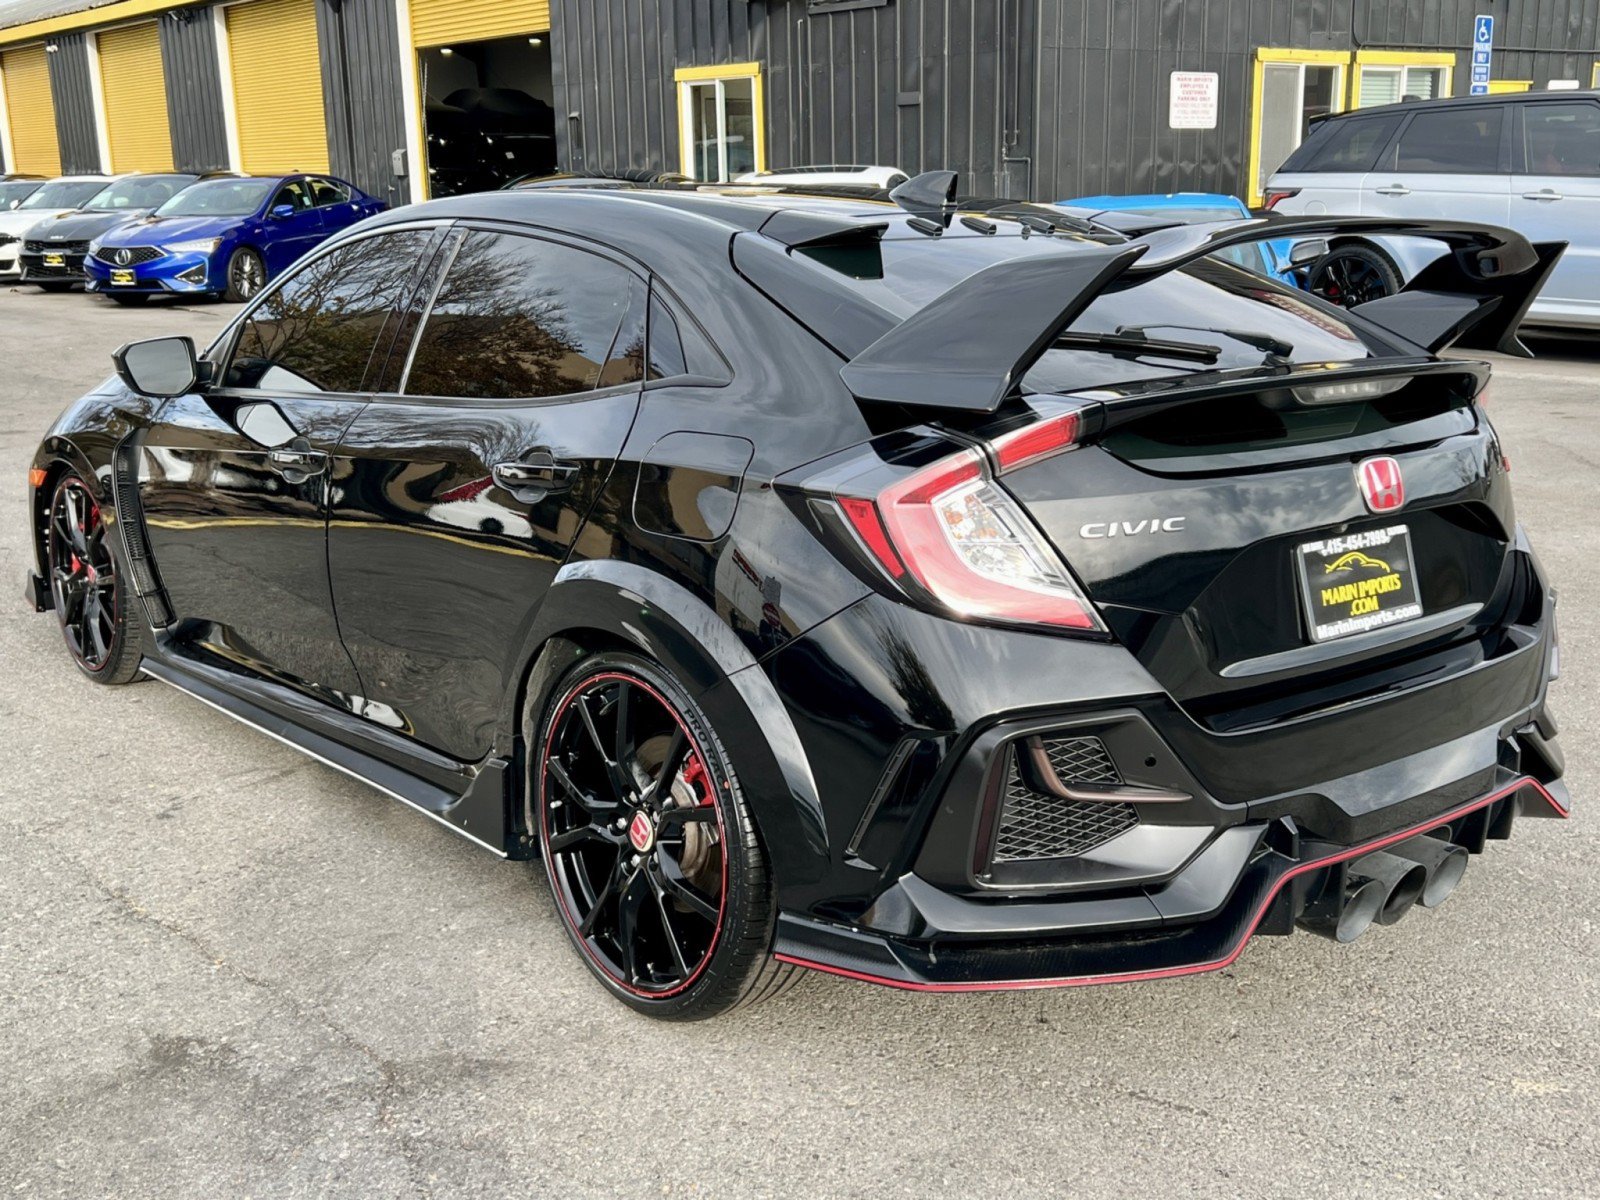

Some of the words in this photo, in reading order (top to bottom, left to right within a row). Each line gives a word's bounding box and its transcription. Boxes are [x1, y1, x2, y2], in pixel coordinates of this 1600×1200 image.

[1080, 517, 1185, 539] CIVIC
[1322, 583, 1358, 606] MARIN
[1357, 573, 1401, 597] IMPORTS
[1351, 596, 1379, 616] .COM
